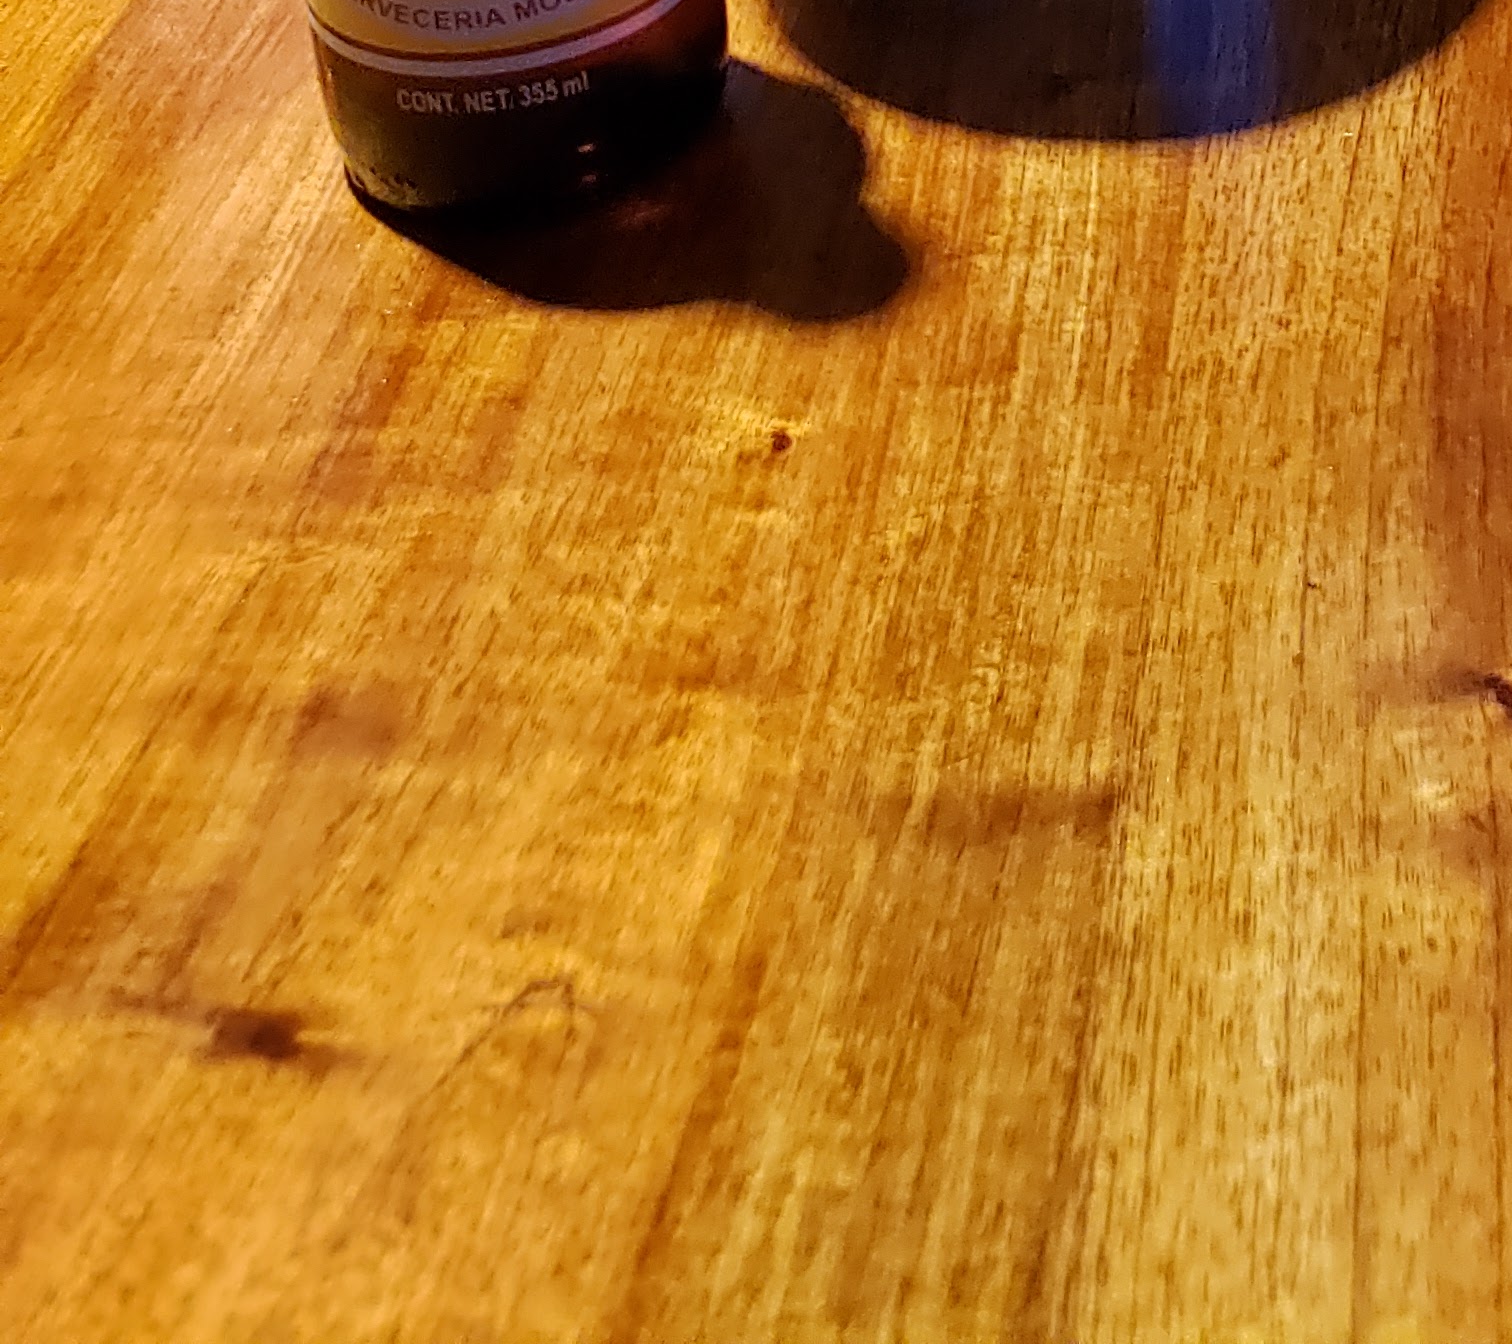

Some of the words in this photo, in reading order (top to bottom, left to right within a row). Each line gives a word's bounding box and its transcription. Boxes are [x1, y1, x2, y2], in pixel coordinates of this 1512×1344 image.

[396, 87, 459, 113] CONT.
[518, 78, 559, 106] 355
[562, 71, 590, 96] ml
